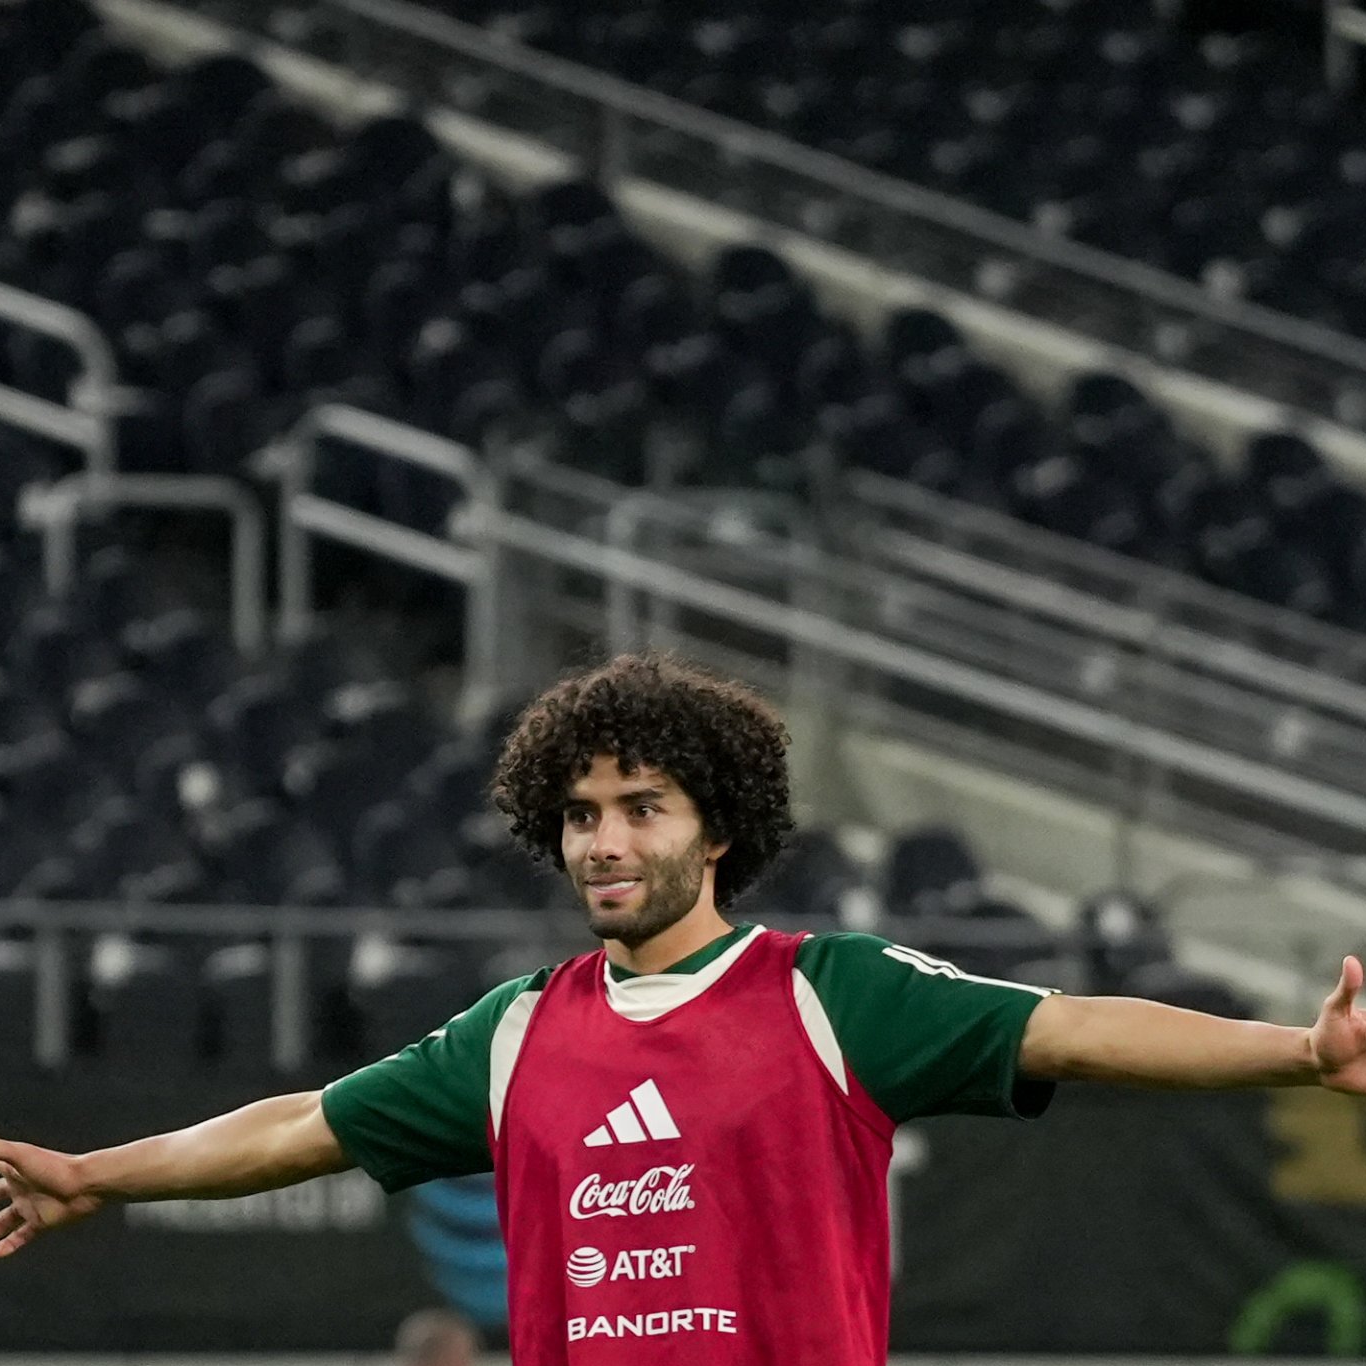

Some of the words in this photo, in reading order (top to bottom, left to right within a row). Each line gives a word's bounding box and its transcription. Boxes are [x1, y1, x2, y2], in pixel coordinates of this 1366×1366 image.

[570, 1163, 694, 1220] Coca-Cola
[609, 1246, 686, 1281] AT&T
[567, 1307, 737, 1342] BANORTE
